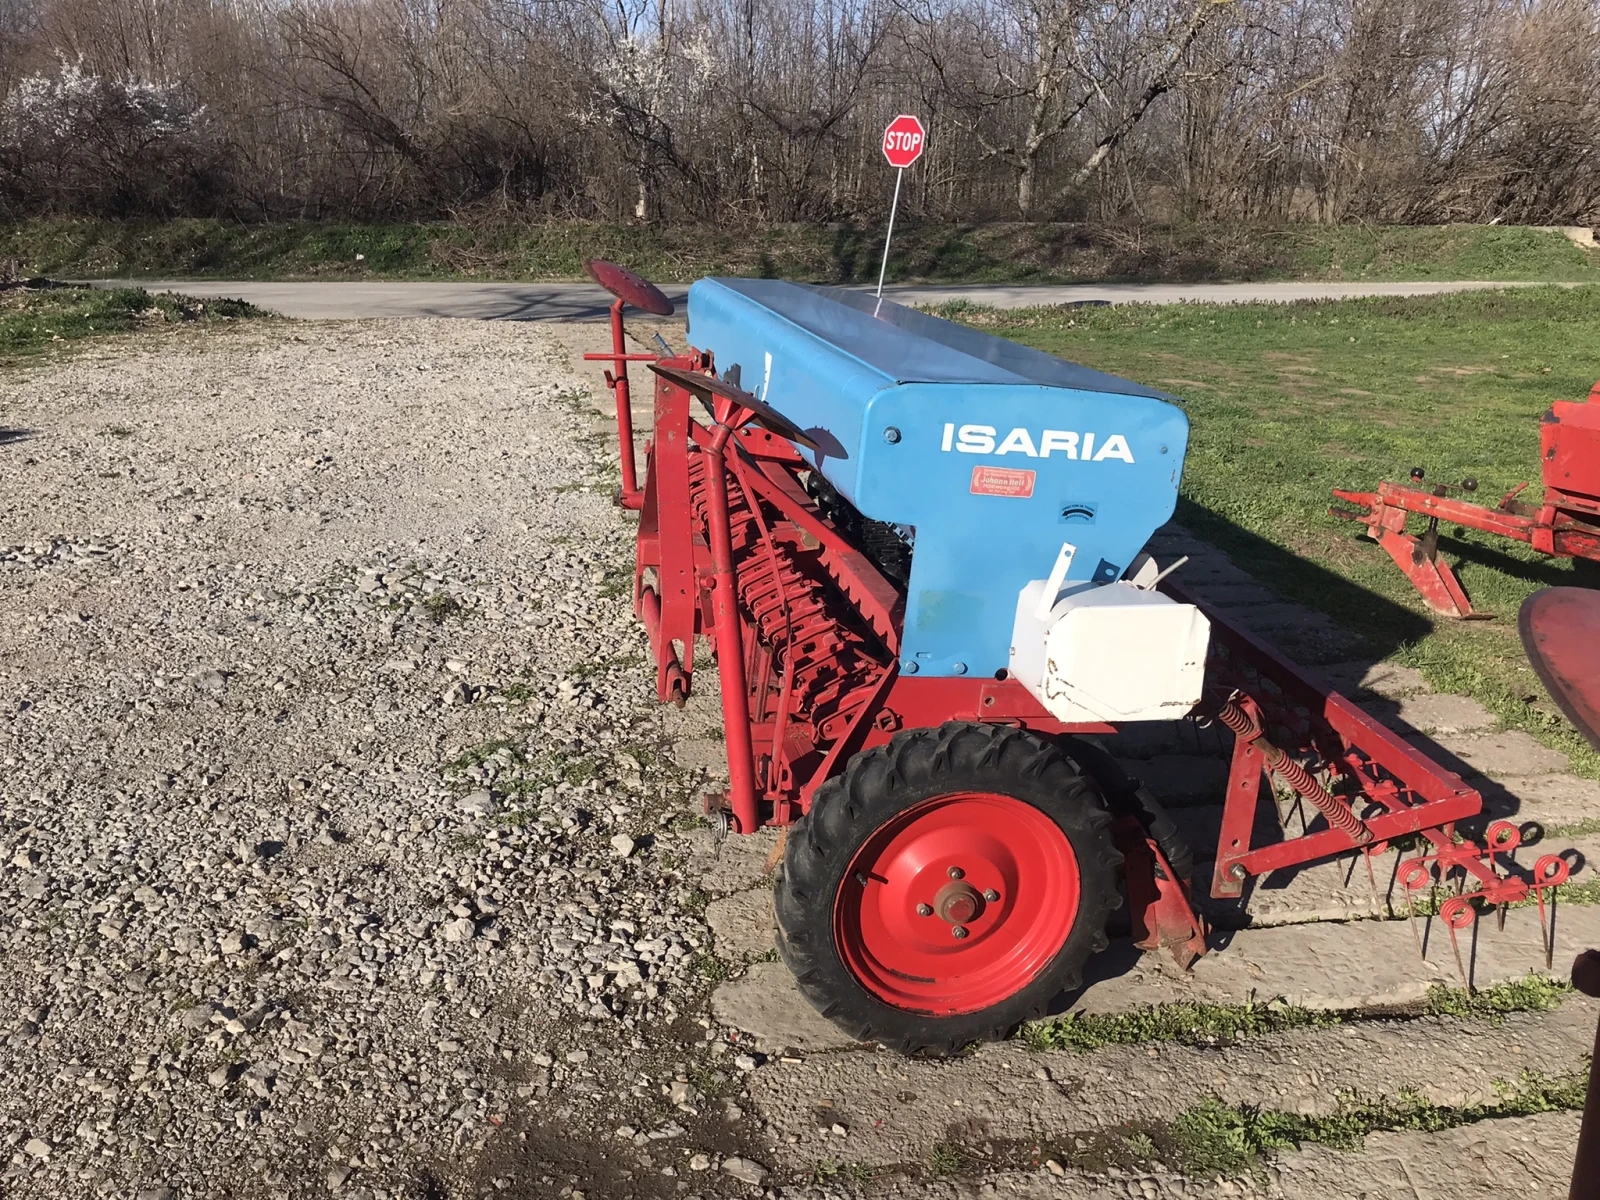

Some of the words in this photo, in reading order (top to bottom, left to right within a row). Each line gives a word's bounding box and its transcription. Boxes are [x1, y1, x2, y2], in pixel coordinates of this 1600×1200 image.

[886, 131, 921, 151] STOP
[941, 423, 1135, 463] ISARIA
[980, 476, 1008, 485] Johann
